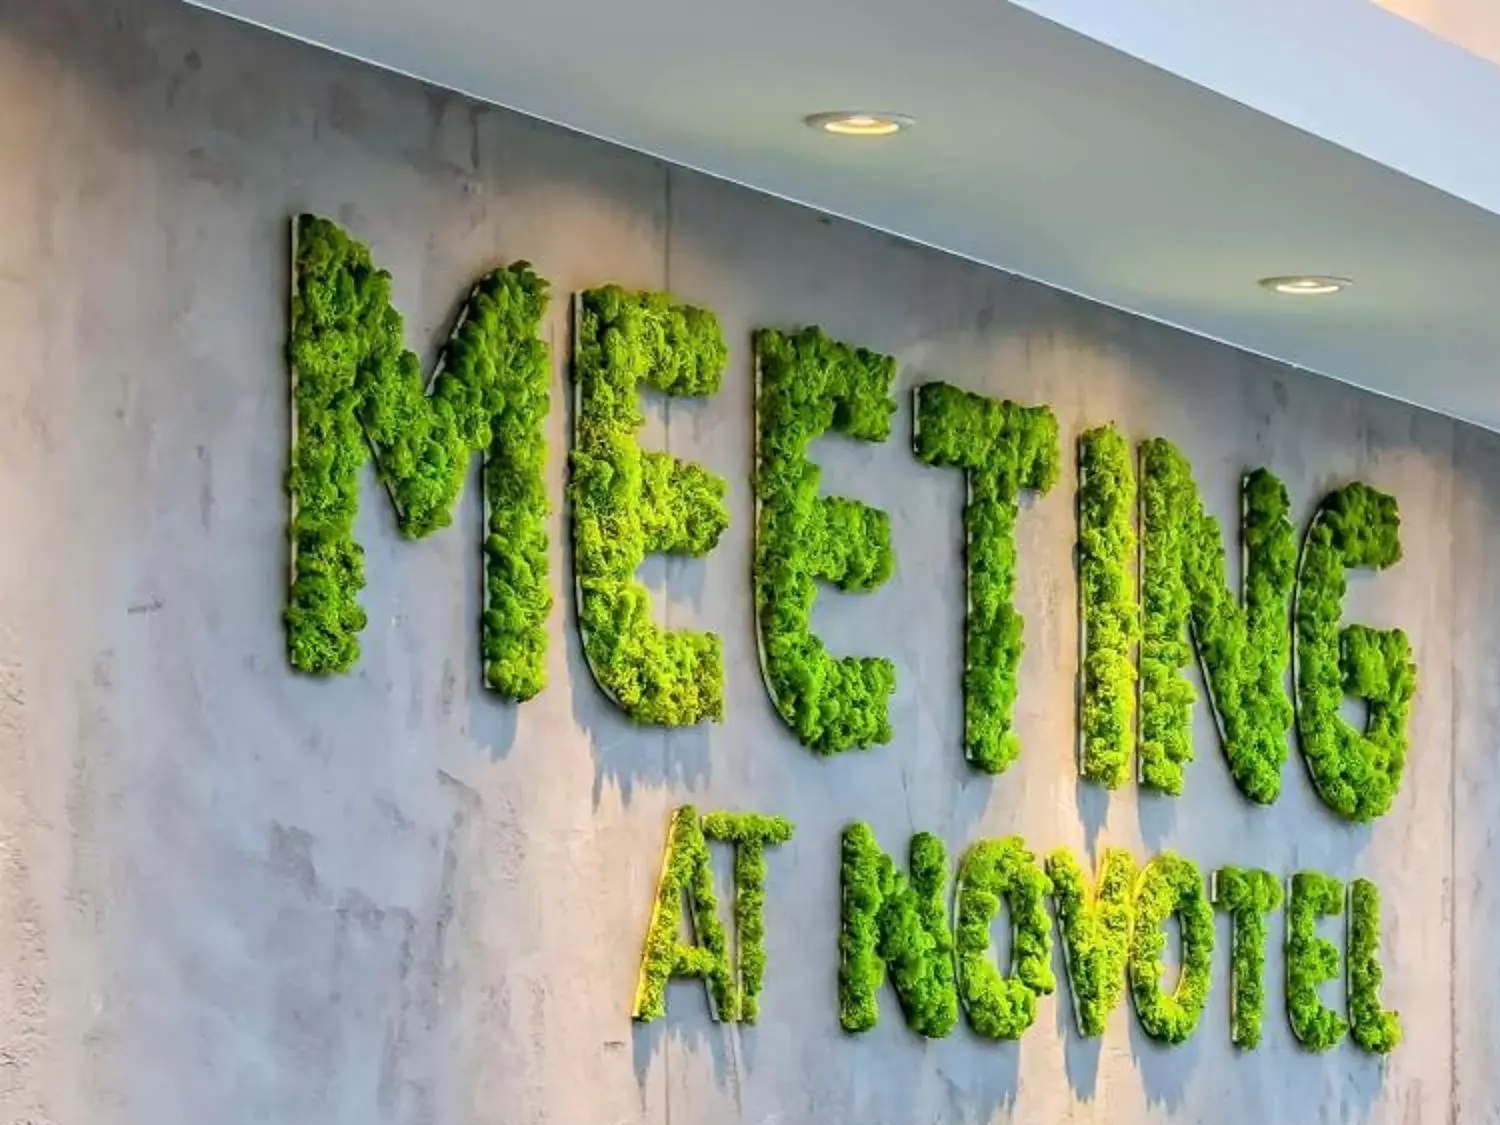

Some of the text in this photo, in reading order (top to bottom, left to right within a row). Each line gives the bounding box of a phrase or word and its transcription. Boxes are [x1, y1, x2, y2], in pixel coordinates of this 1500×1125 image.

[284, 212, 1416, 825] MEETING
[634, 804, 1403, 1055] AT NOVOTEL
